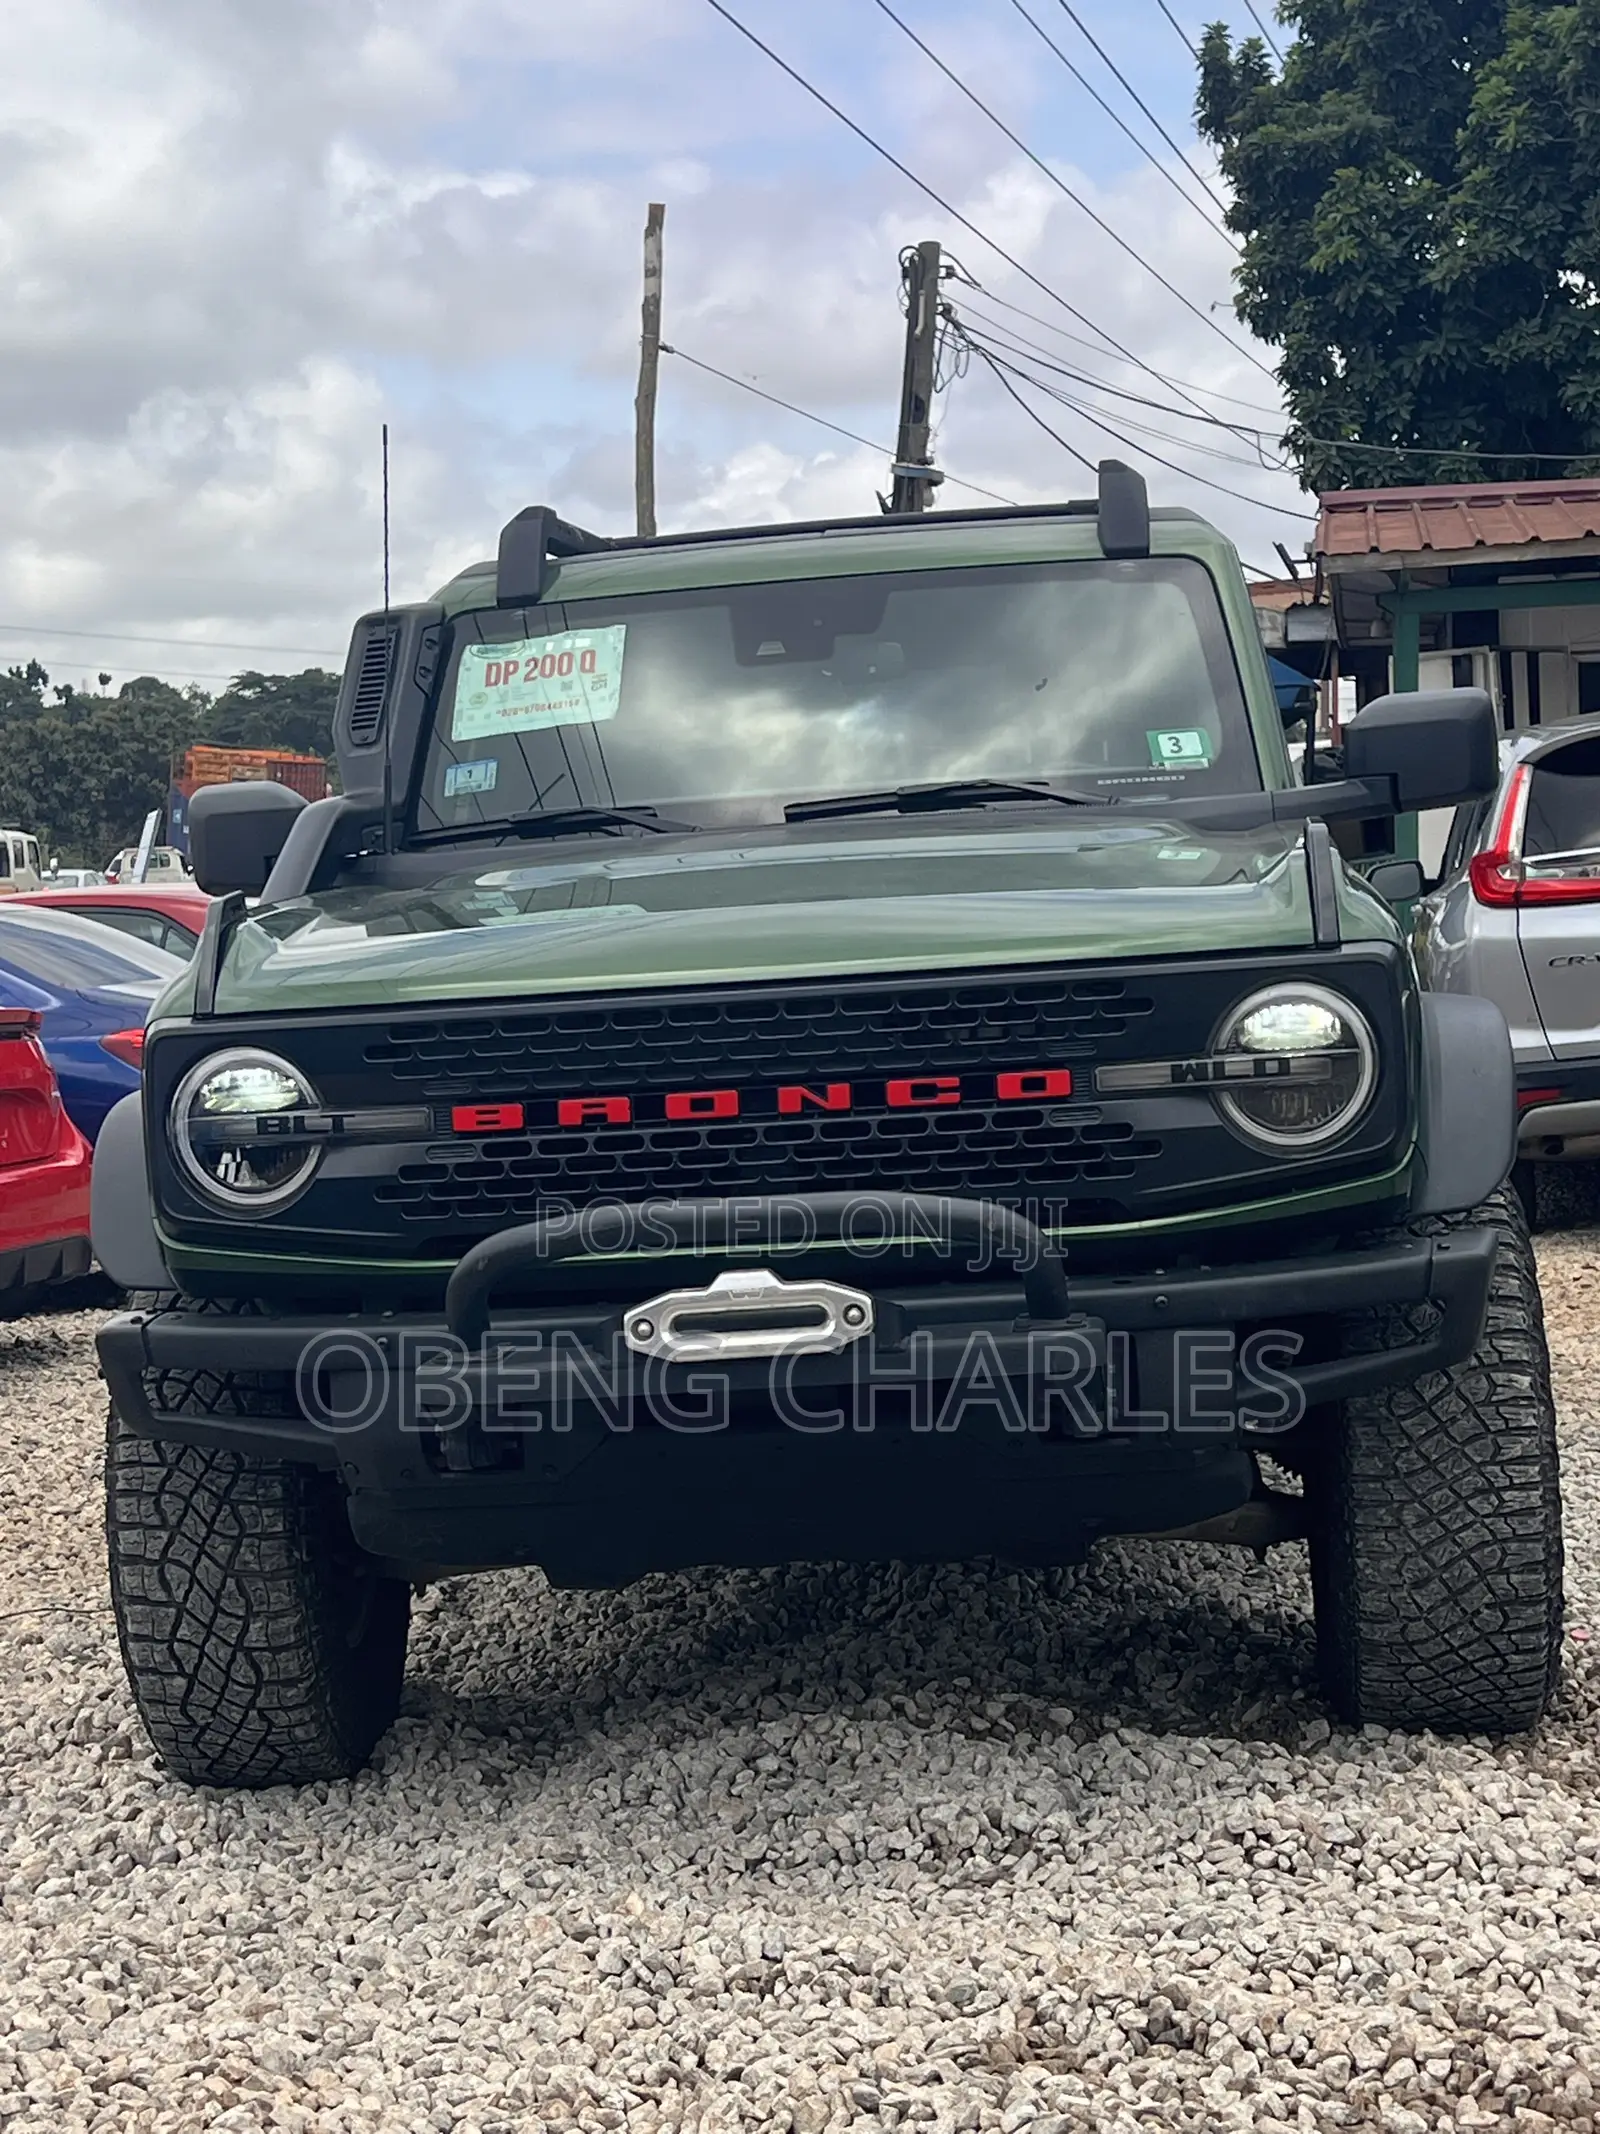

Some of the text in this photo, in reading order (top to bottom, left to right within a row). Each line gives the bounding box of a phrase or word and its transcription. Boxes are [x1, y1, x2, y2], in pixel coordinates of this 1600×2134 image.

[485, 660, 519, 687] DP
[524, 652, 574, 683] 200
[1167, 736, 1183, 754] 3
[467, 769, 473, 779] 1
[452, 1068, 1072, 1133] BRONCO
[256, 1114, 356, 1136] BLT
